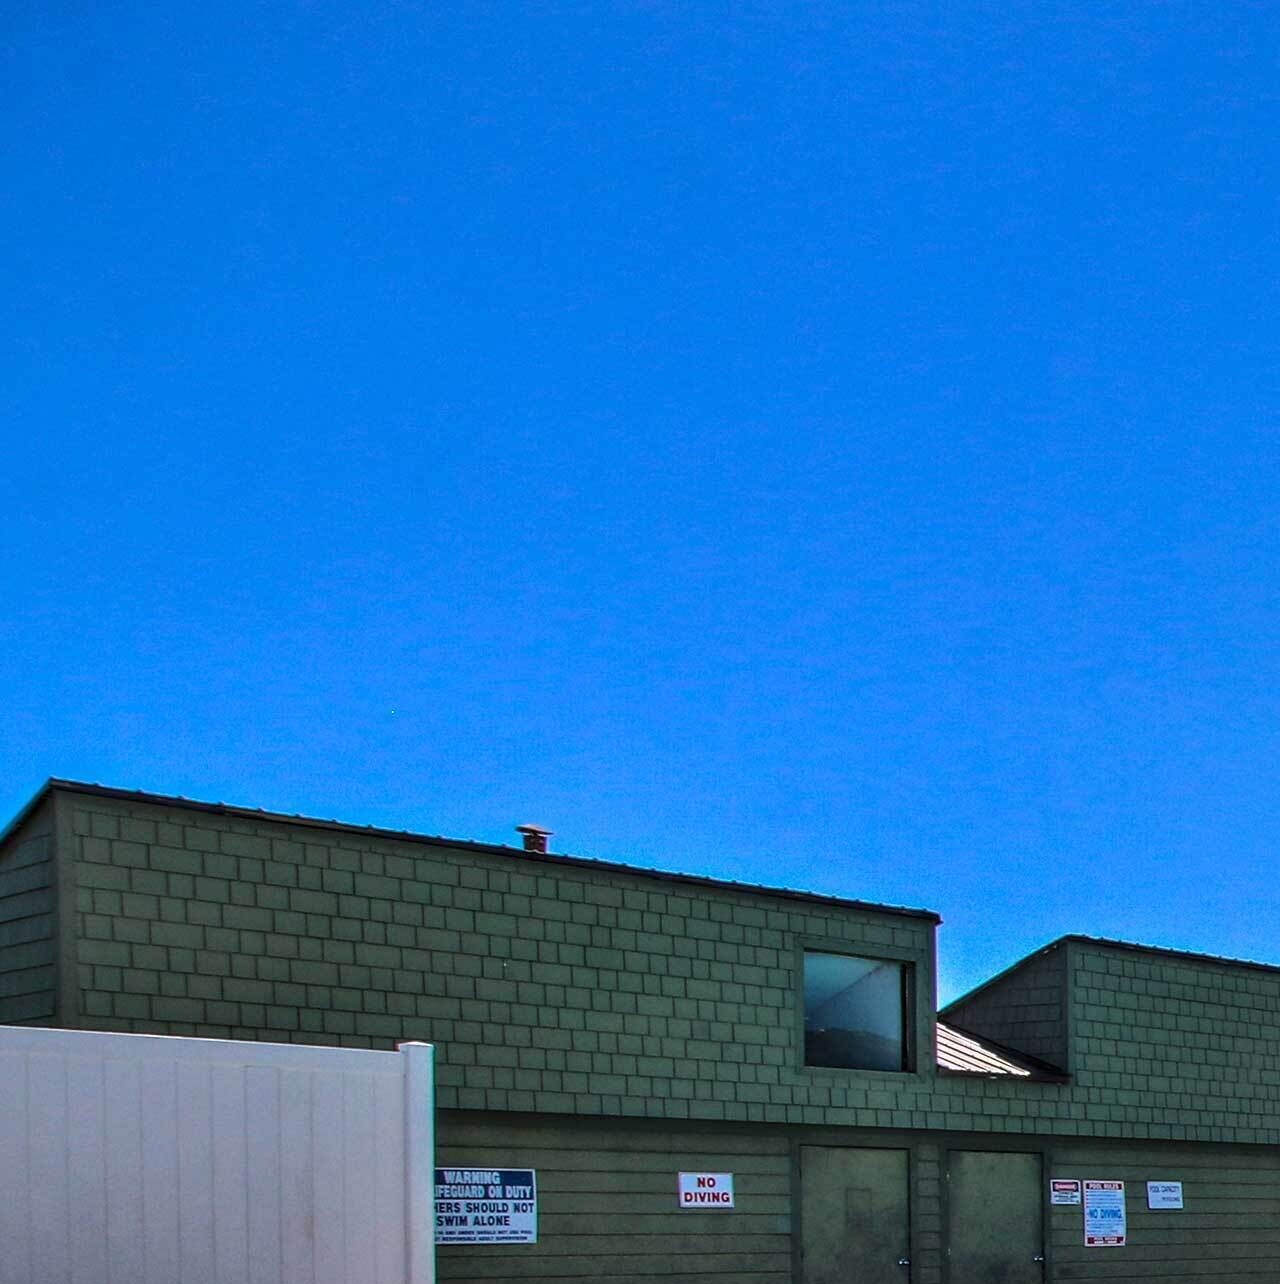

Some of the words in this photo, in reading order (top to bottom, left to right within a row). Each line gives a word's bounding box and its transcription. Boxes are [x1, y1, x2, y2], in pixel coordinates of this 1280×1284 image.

[443, 1171, 500, 1185] WARNING
[697, 1177, 716, 1188] NO
[435, 1185, 485, 1198] IFEGUARD
[488, 1185, 503, 1198] ON
[505, 1185, 532, 1198] DUTY
[684, 1192, 730, 1202] DIVING
[466, 1202, 509, 1213] SHOULD
[513, 1202, 534, 1213] NOT
[437, 1215, 468, 1226] SWIM
[473, 1215, 511, 1226] ALONE
